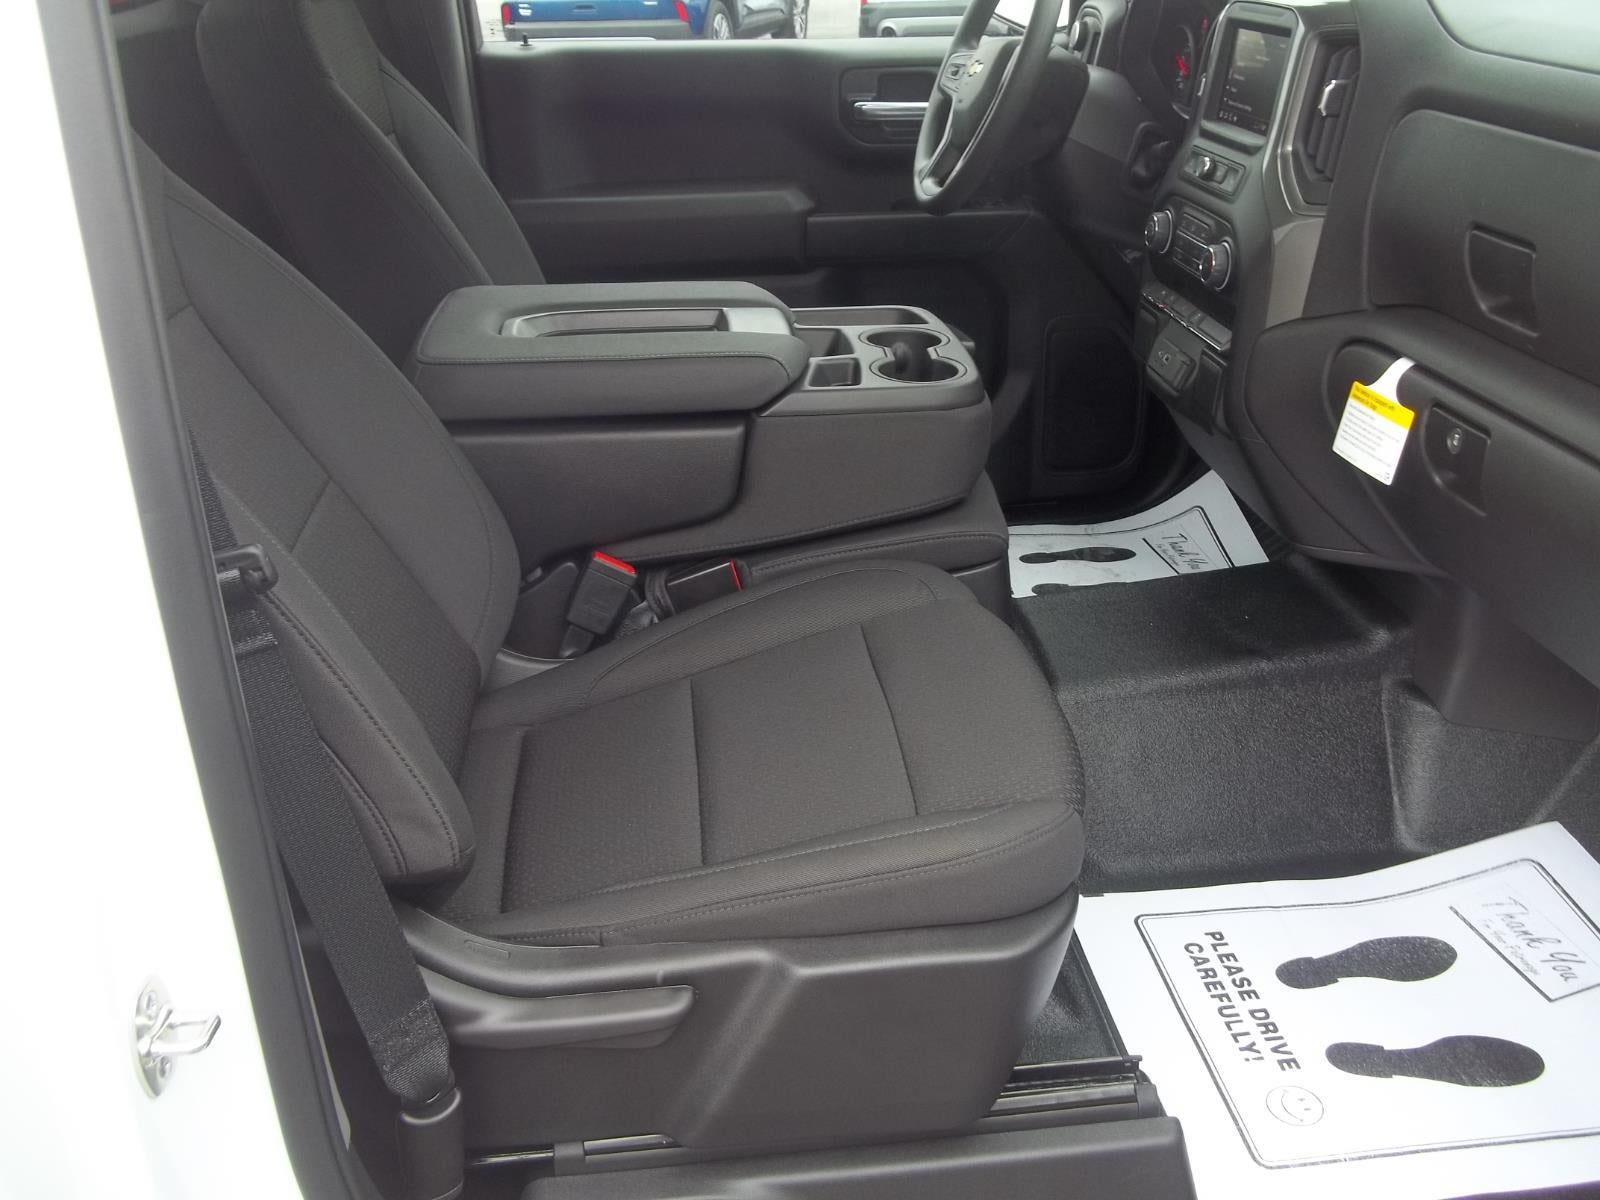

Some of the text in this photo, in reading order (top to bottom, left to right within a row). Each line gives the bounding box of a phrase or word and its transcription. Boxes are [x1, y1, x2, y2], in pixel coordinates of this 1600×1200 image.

[1481, 896, 1562, 949] Thank
[1540, 951, 1587, 982] You
[1183, 942, 1265, 1062] CAREFULLY!
[1204, 930, 1301, 1072] PLEASE DRIVE
